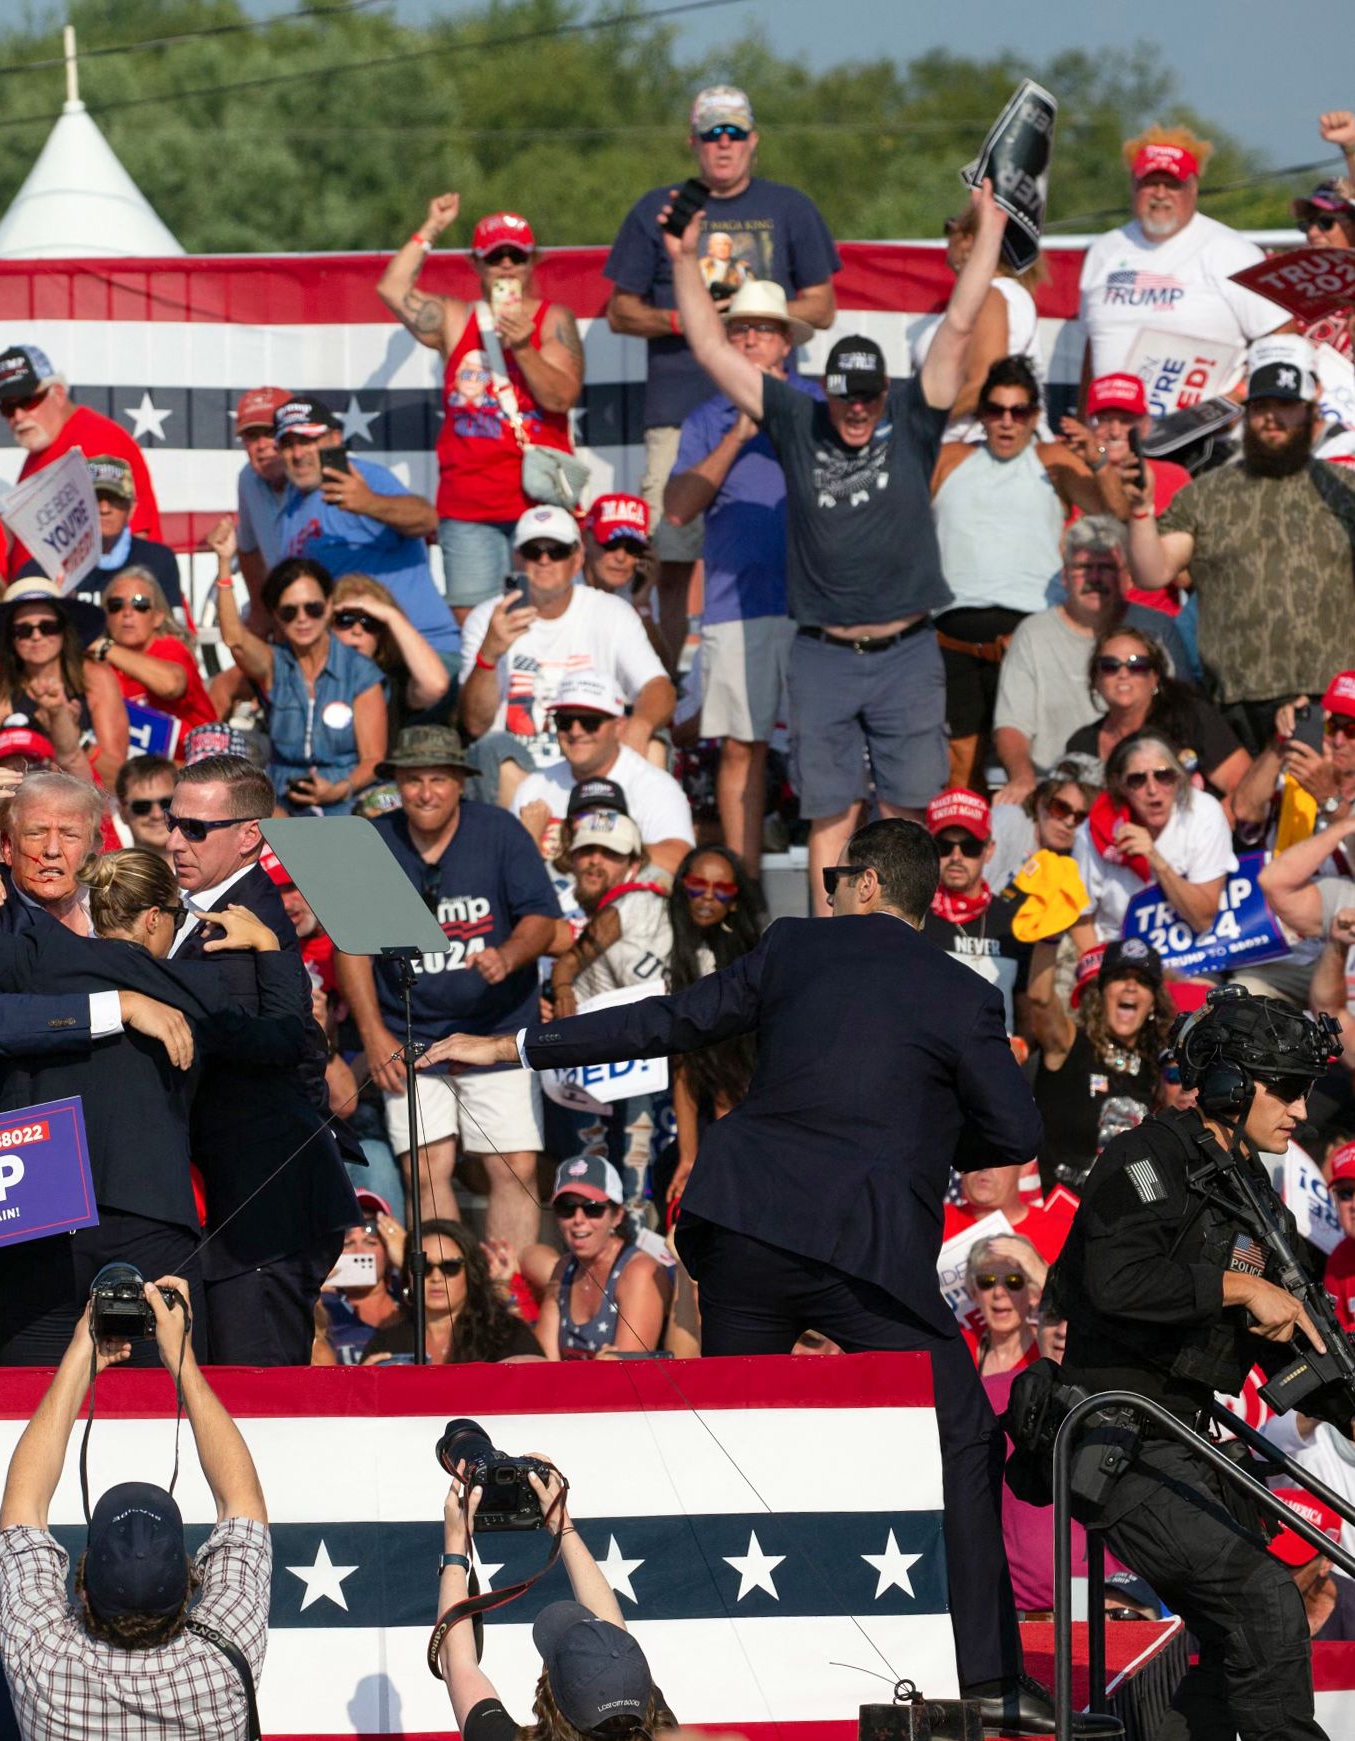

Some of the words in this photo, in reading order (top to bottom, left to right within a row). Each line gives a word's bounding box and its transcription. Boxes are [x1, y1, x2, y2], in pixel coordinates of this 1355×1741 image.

[1102, 286, 1184, 306] TRUMP
[1176, 355, 1217, 412] ED!
[42, 498, 90, 554] YOU'RE
[599, 500, 645, 526] MAGA
[954, 936, 1000, 956] NEVER
[1207, 945, 1226, 958] TO
[582, 1059, 650, 1086] ED!
[1230, 1258, 1263, 1278] POLICE
[191, 1622, 227, 1649] SONY
[429, 1622, 448, 1663] Canon
